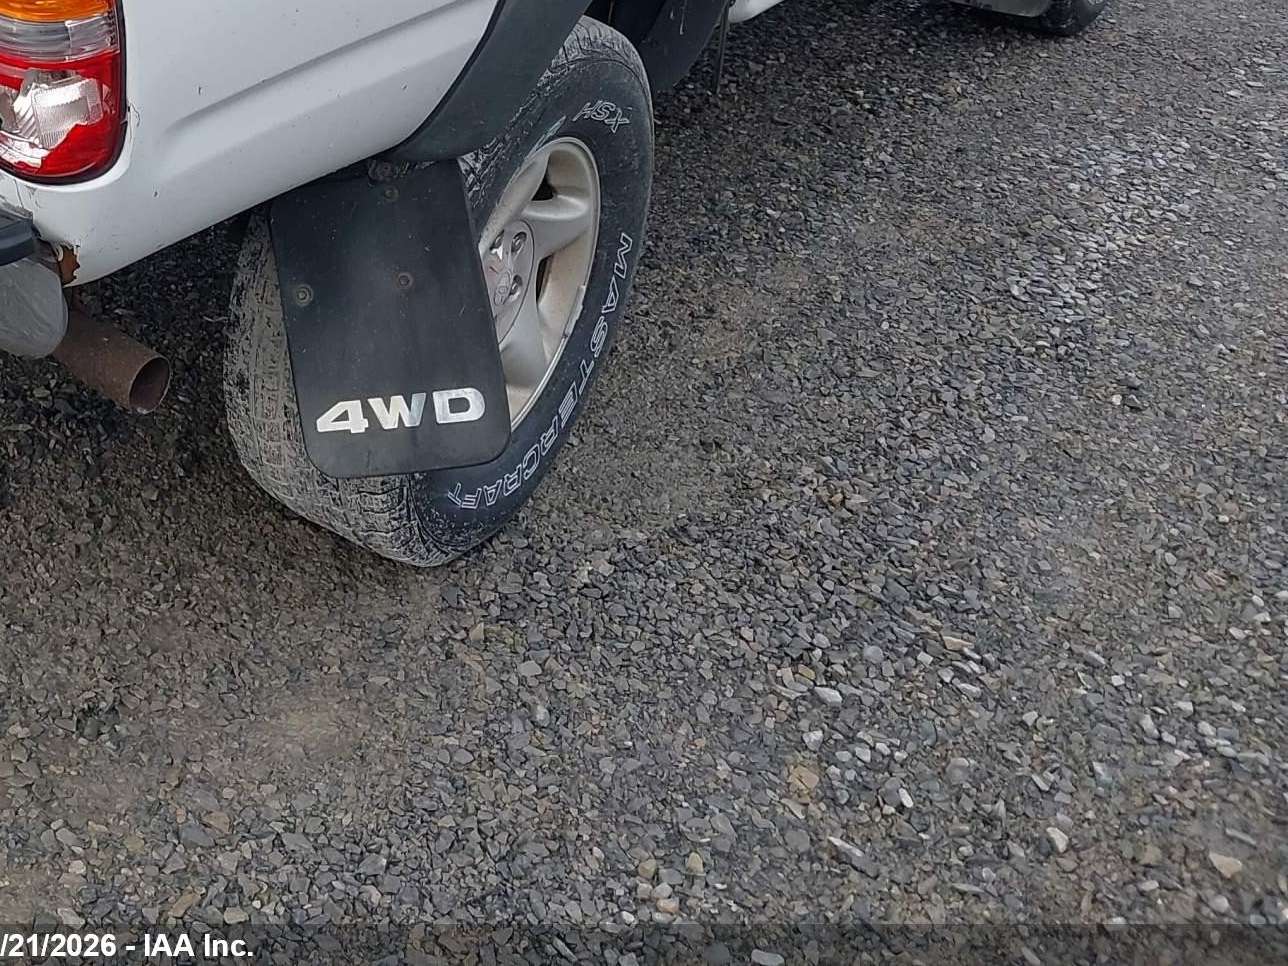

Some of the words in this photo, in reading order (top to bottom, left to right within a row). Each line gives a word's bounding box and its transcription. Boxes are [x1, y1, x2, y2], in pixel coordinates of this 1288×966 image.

[572, 100, 630, 133] HSX
[447, 233, 633, 510] MASTERCRAFT
[315, 387, 486, 434] 4WD
